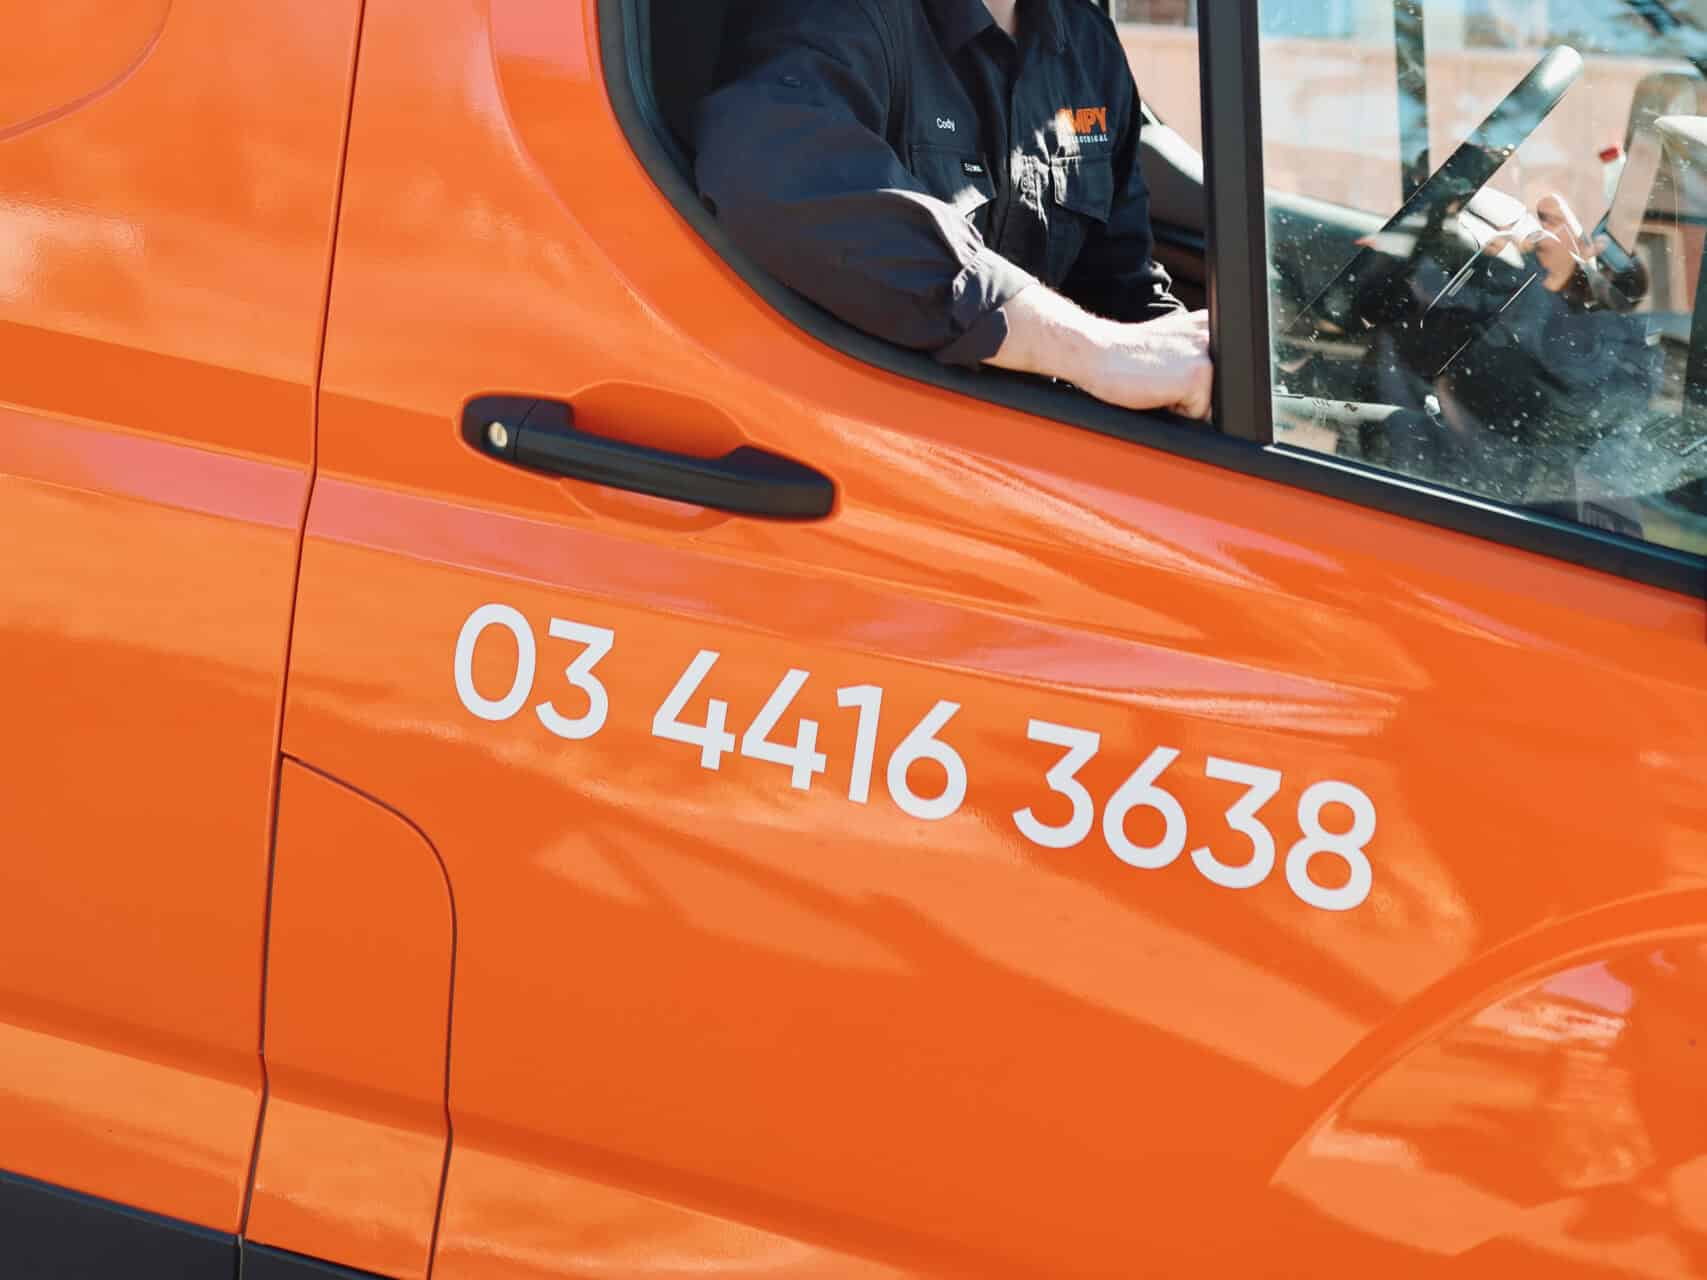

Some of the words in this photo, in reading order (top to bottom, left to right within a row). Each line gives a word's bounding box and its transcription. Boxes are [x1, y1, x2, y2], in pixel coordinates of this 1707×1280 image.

[936, 117, 955, 132] Cody
[455, 604, 614, 739] 03
[652, 650, 967, 820] 4416
[1013, 719, 1376, 910] 3638
